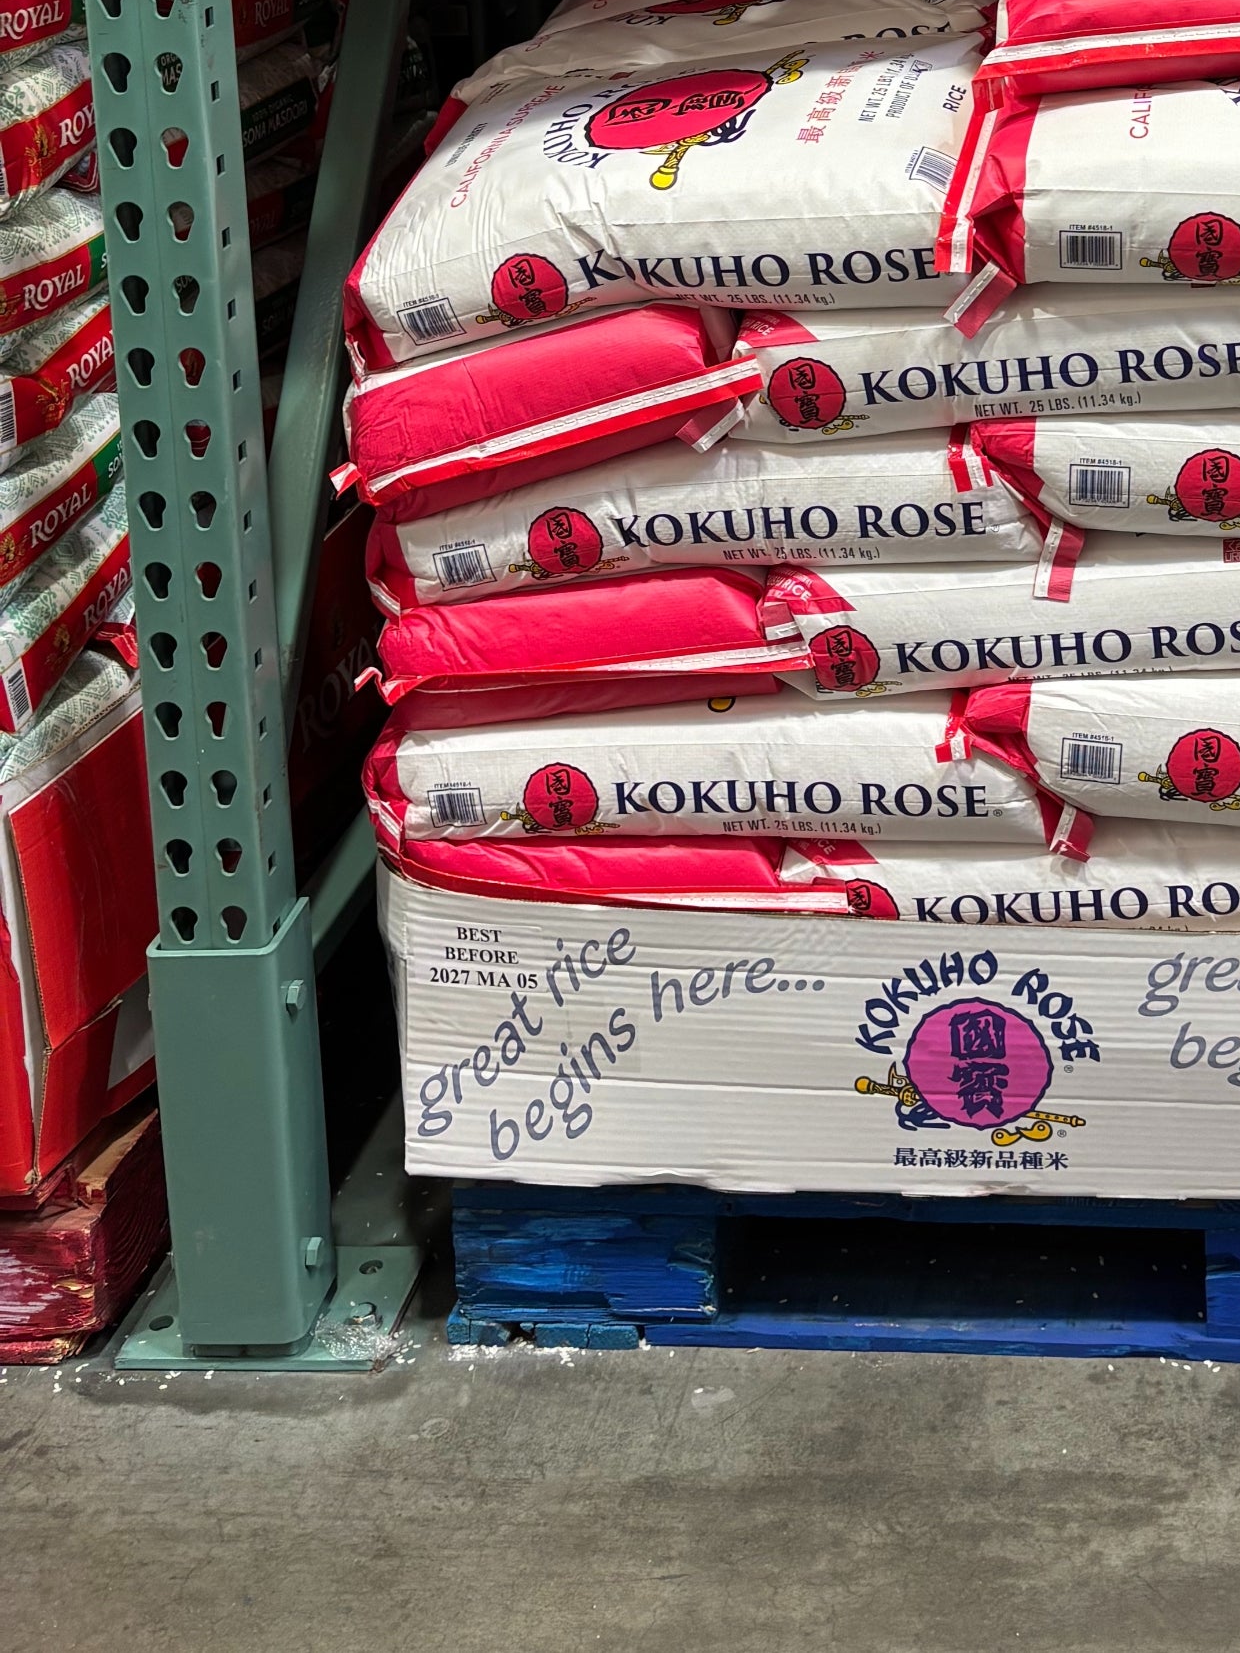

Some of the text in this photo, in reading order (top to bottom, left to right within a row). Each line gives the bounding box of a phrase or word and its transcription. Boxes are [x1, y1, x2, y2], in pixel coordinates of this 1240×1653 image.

[242, 99, 308, 148] SONA MASOORI
[23, 263, 85, 310] ROYAL
[862, 352, 1099, 406] KOKUHO
[974, 391, 1142, 418] NET WT. 25 LBS. (11.34 kg.)
[29, 483, 92, 549] ROYAL
[613, 500, 986, 547] KOKUHO ROSE
[894, 628, 1133, 674] KOKUHO
[612, 779, 991, 819] KOKUHO ROSE
[444, 947, 519, 965] BEFORE
[456, 926, 502, 943] BEST
[429, 969, 538, 990] 2027 MA 05
[854, 949, 1101, 1065] KOKUHO ROSE
[418, 927, 636, 1138] great rice
[488, 956, 826, 1161] begins here...
[892, 1146, 1069, 1171] 最高級新品種米
